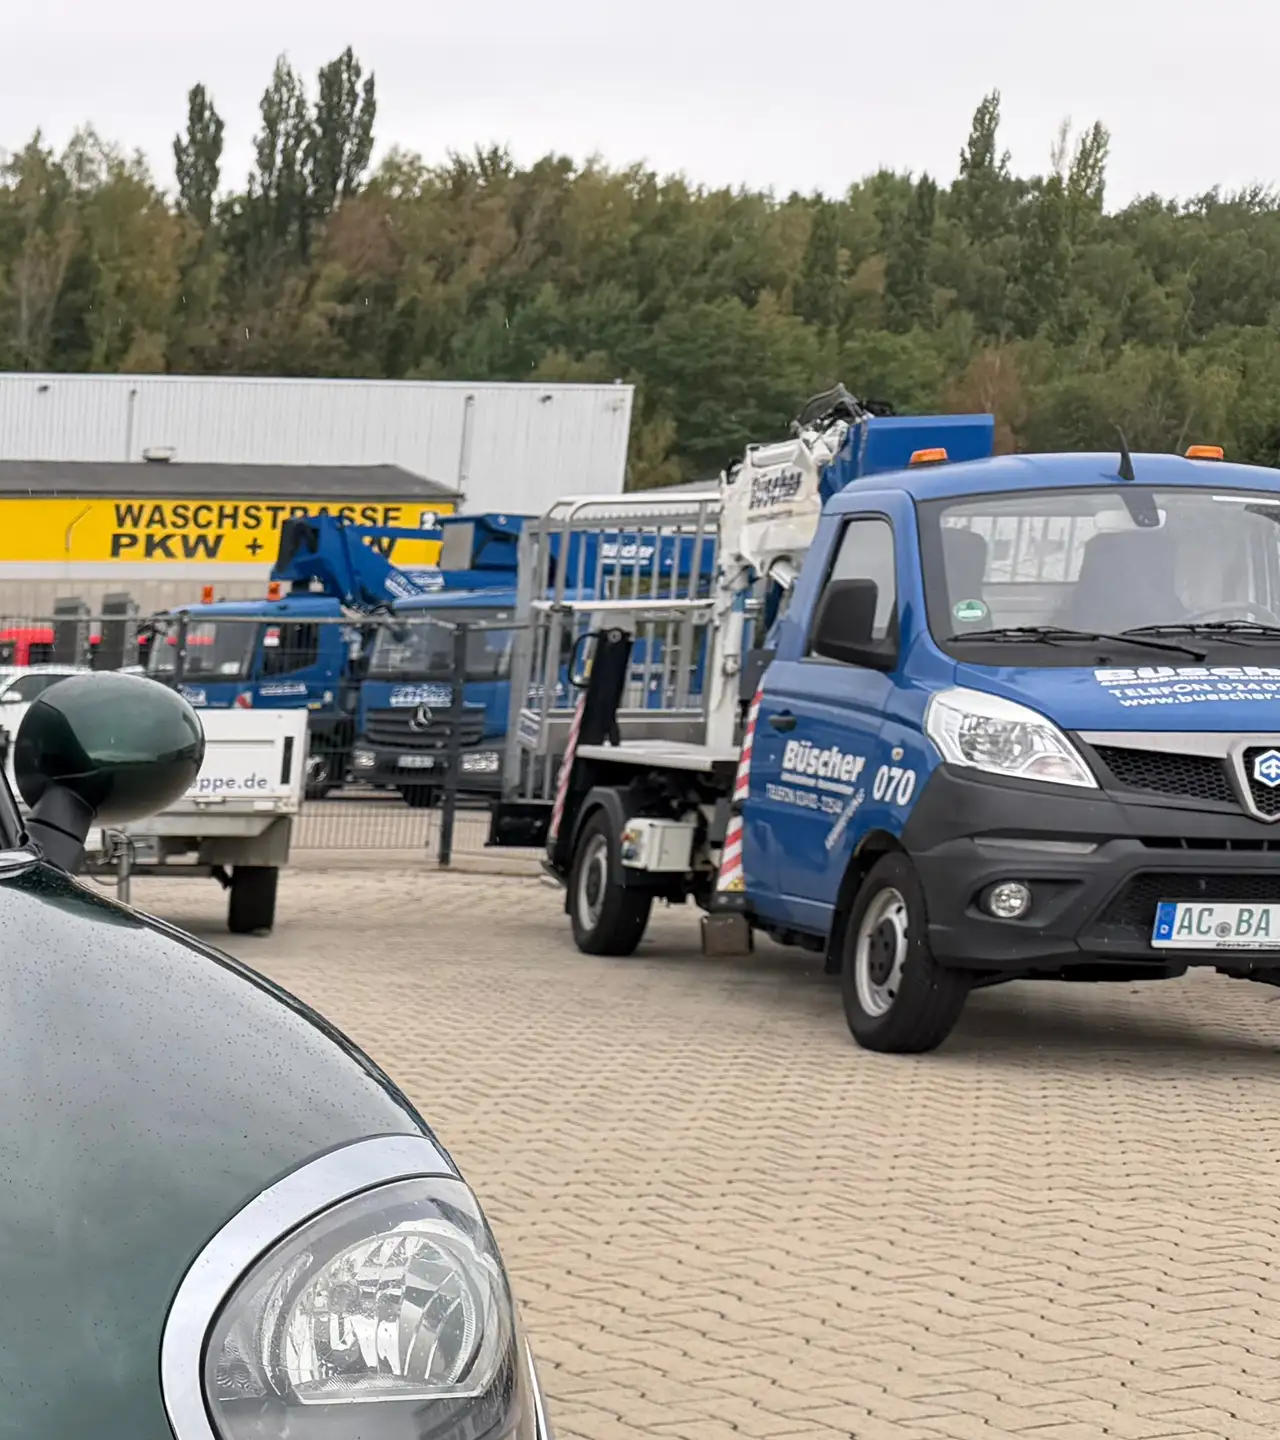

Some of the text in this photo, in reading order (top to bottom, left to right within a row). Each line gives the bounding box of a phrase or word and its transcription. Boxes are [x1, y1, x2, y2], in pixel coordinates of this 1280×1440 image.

[110, 533, 225, 559] PKW
[1108, 683, 1280, 697] TELEFON 0240
[782, 740, 866, 782] Büscher
[189, 772, 268, 793] ppe.de
[872, 764, 916, 806] 070
[1177, 907, 1271, 936] AC BA
